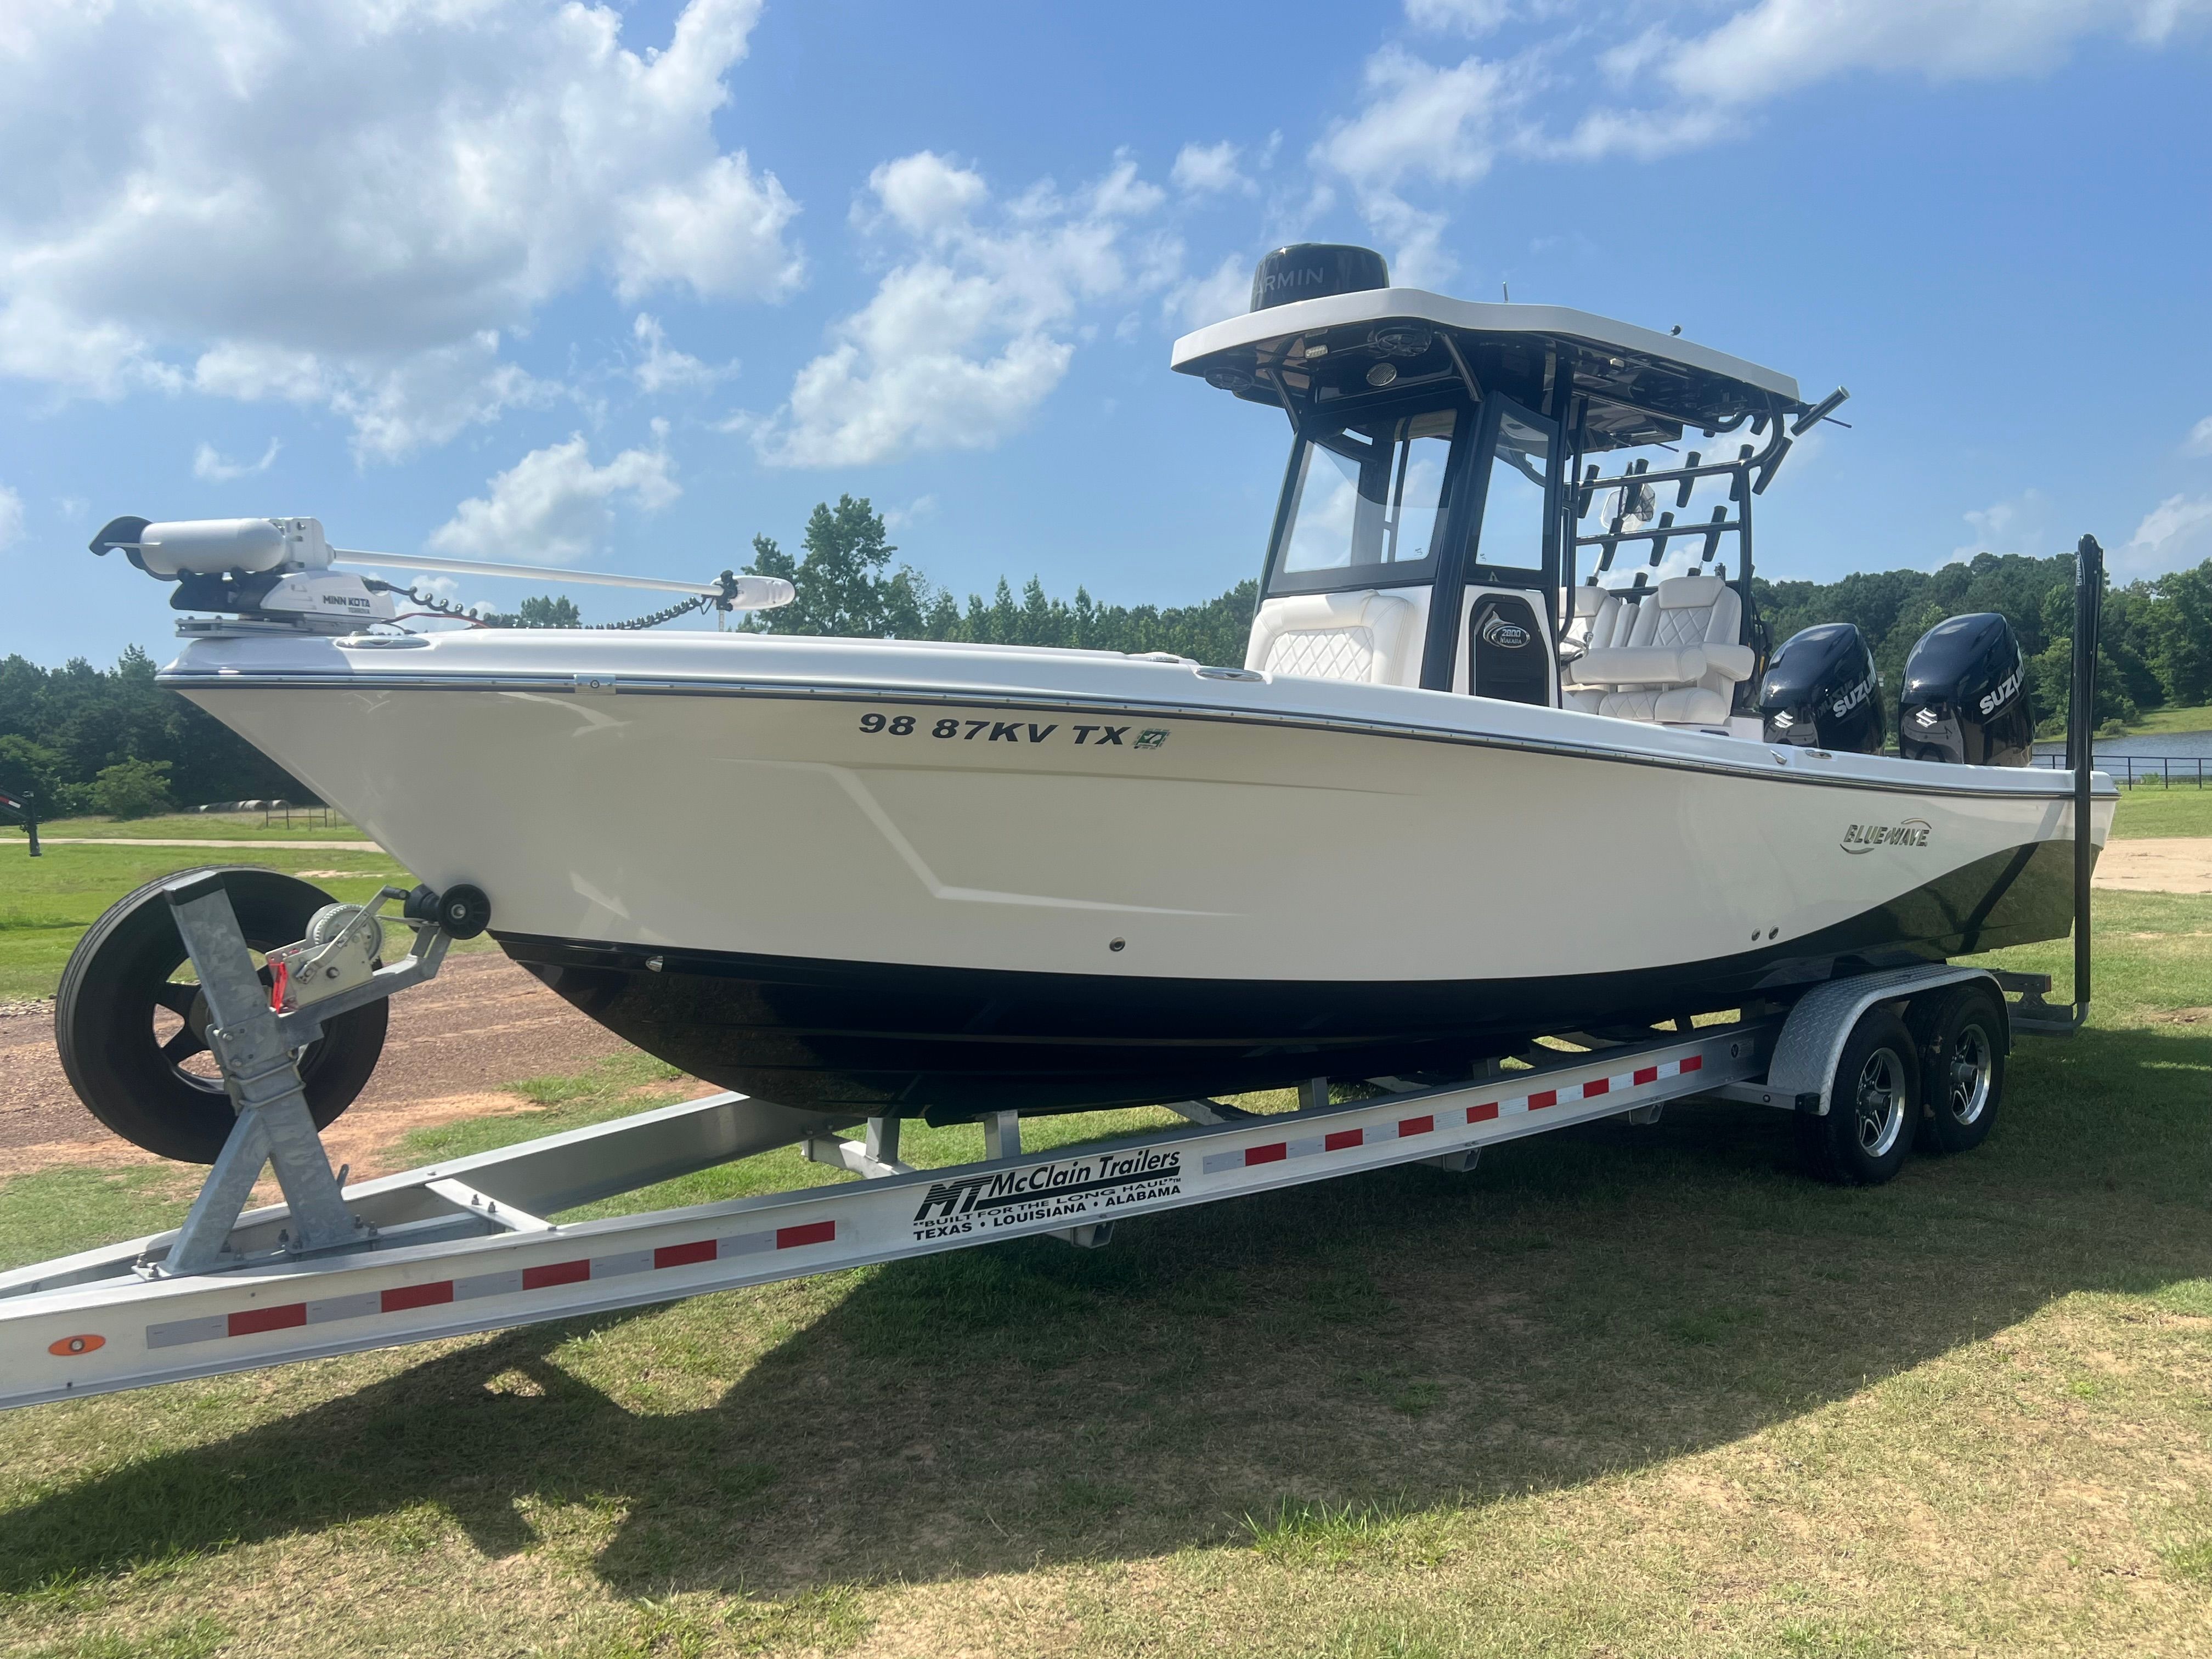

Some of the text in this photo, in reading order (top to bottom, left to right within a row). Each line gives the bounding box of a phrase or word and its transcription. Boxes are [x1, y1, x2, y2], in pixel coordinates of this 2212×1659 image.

[1255, 267, 1324, 294] ARMIN
[323, 595, 370, 607] MINN KOTA
[1502, 629, 1521, 637] 2800
[859, 713, 916, 736] 98
[932, 719, 1058, 743] 87KV
[1072, 725, 1131, 745] TX
[988, 1161, 1091, 1198] McClain
[1099, 1149, 1181, 1178] Trailers
[913, 1185, 1181, 1241] TEXAS LOUISIANA ALABAMA
[978, 1207, 1012, 1218] FOR
[1017, 1200, 1049, 1210] THE
[1057, 1189, 1115, 1204] LONG
